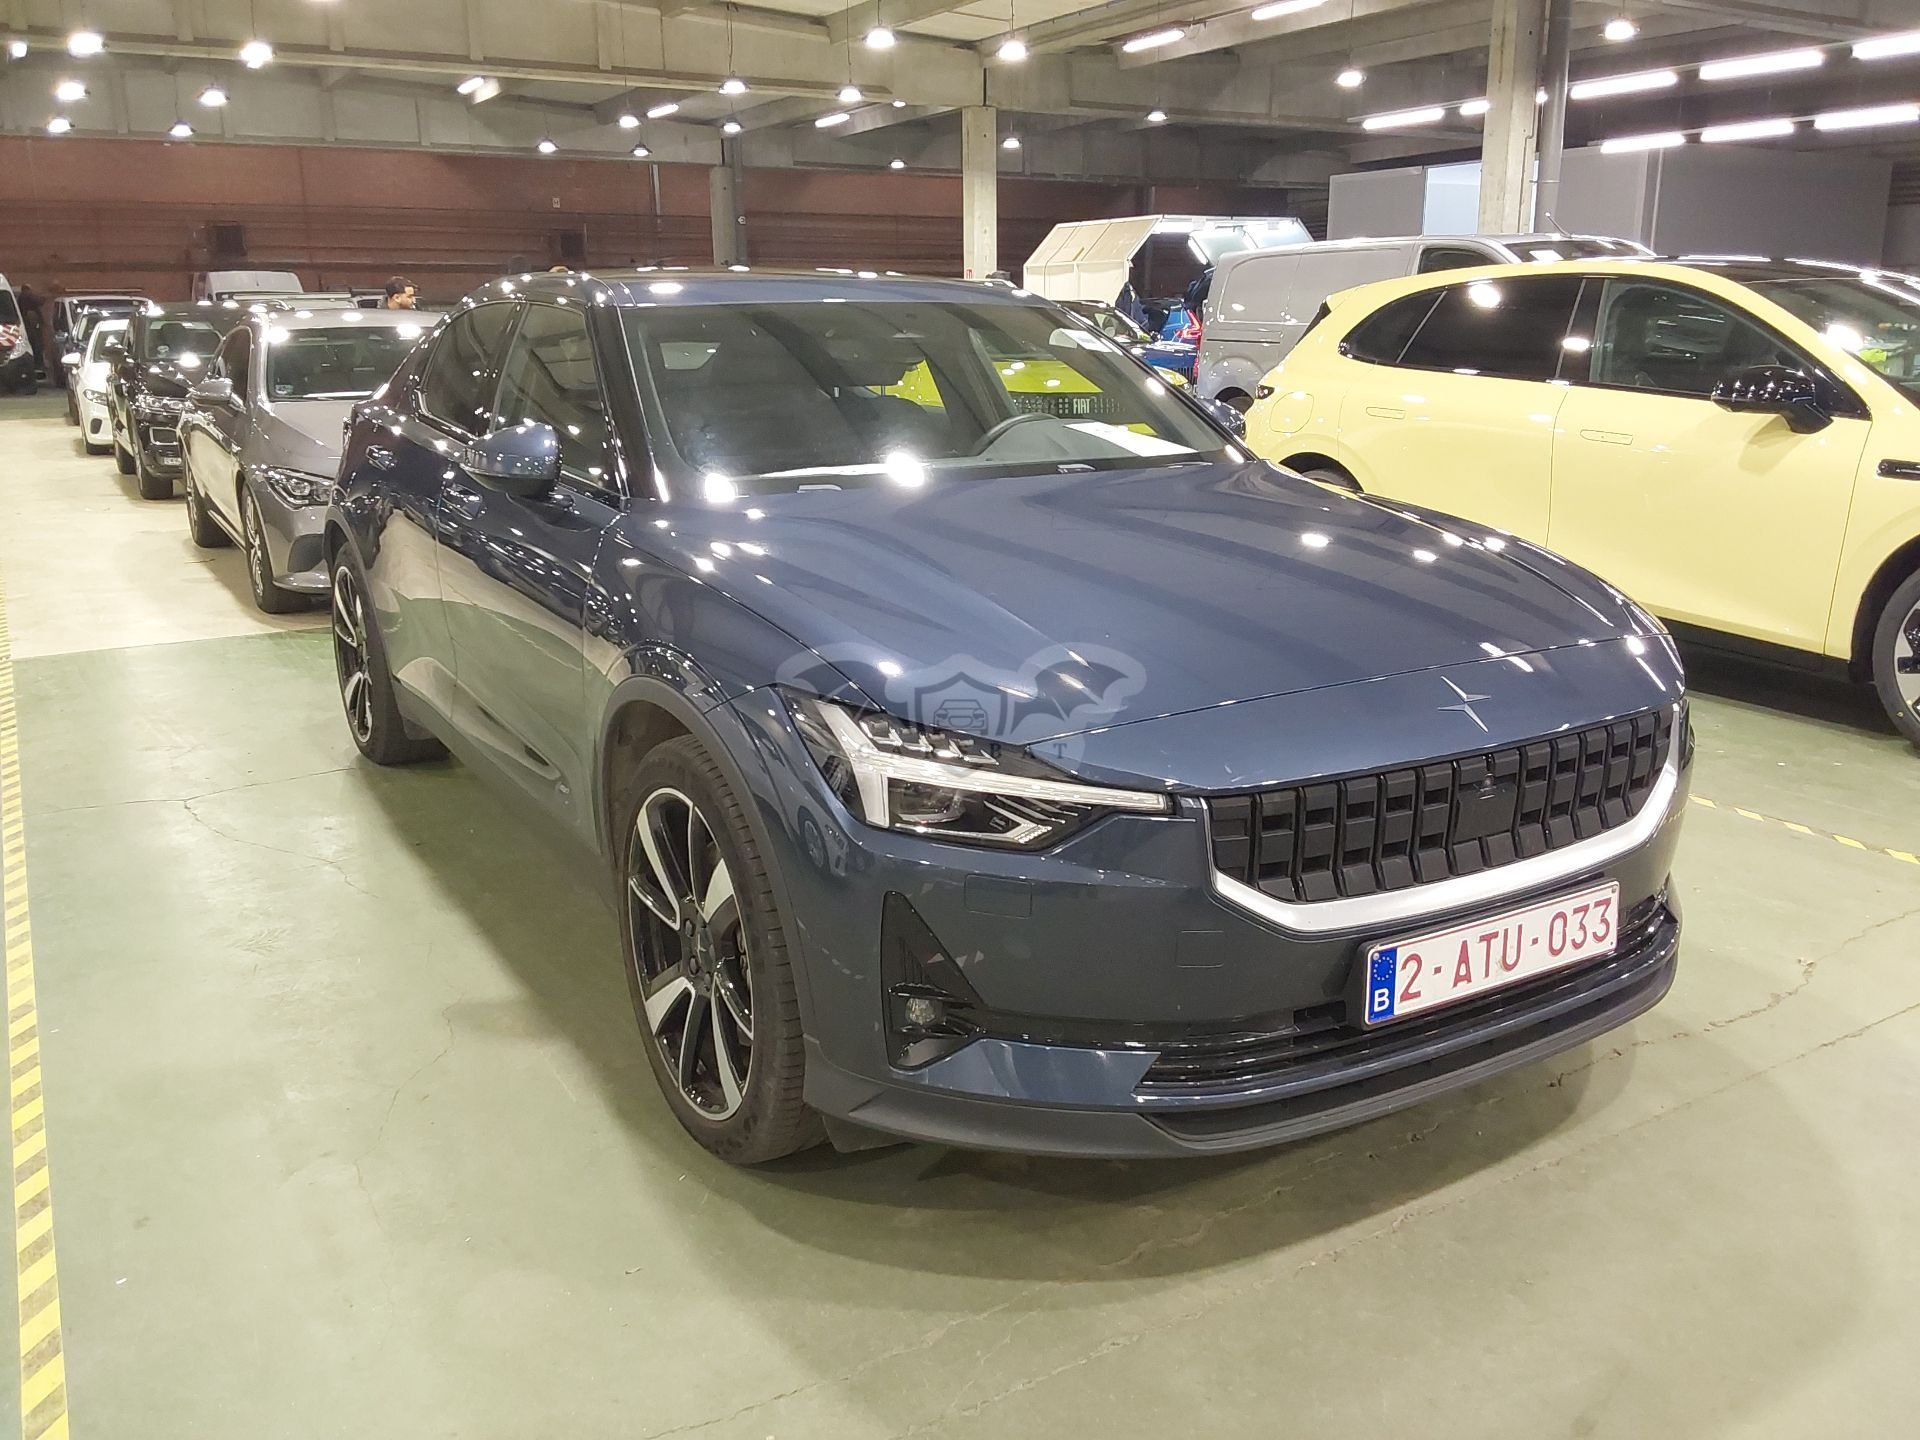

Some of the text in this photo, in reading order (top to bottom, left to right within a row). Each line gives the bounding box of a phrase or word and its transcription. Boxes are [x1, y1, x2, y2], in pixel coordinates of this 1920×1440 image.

[1073, 398, 1091, 414] FIAT
[1399, 898, 1612, 1003] 2-ATU-033
[1373, 988, 1390, 1012] B
